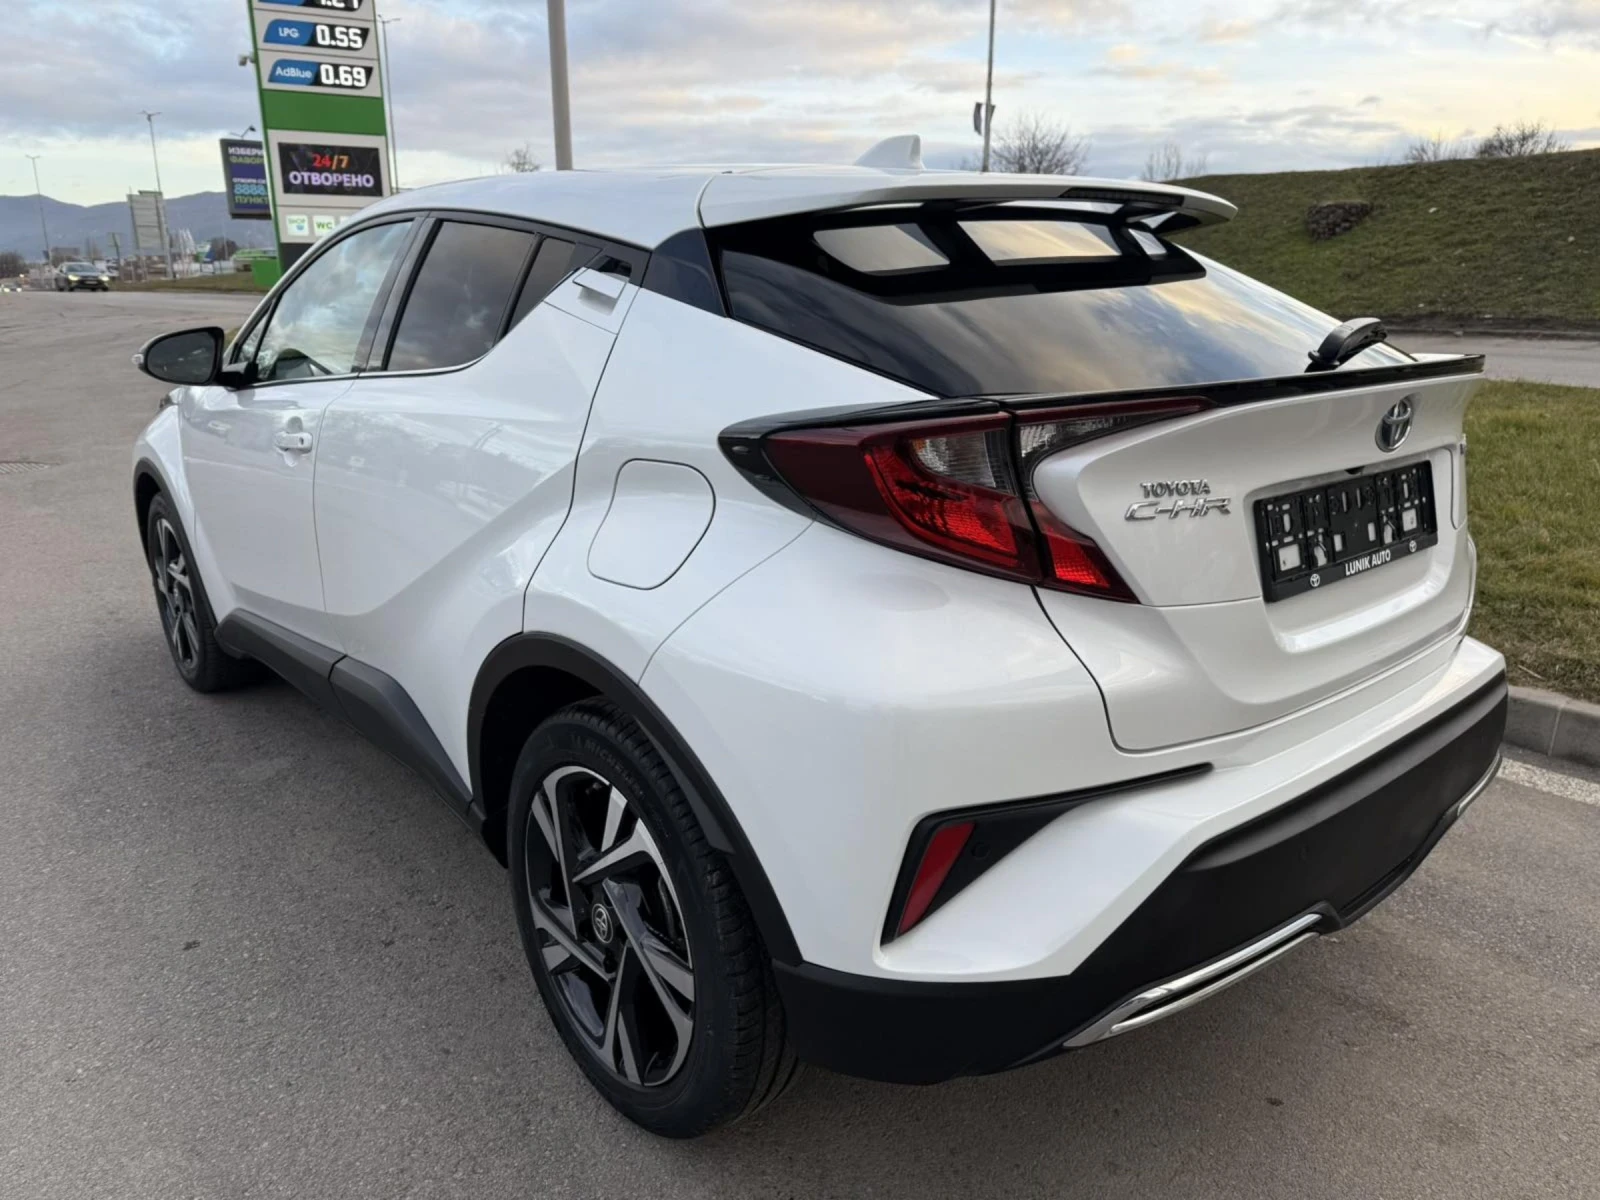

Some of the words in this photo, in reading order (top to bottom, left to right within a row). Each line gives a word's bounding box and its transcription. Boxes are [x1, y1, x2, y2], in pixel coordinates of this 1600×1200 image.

[278, 27, 300, 38] LPG
[315, 24, 363, 49] 0.55
[275, 66, 313, 79] AdBlue
[320, 64, 367, 87] 0.69
[312, 153, 349, 170] 24/7
[289, 171, 374, 188] ОТВОРЕНО
[316, 221, 333, 229] WC
[1140, 479, 1211, 499] TOYOTA
[1124, 497, 1231, 521] C-HR
[1345, 555, 1371, 576] LUNIK
[1371, 548, 1391, 567] AUTO
